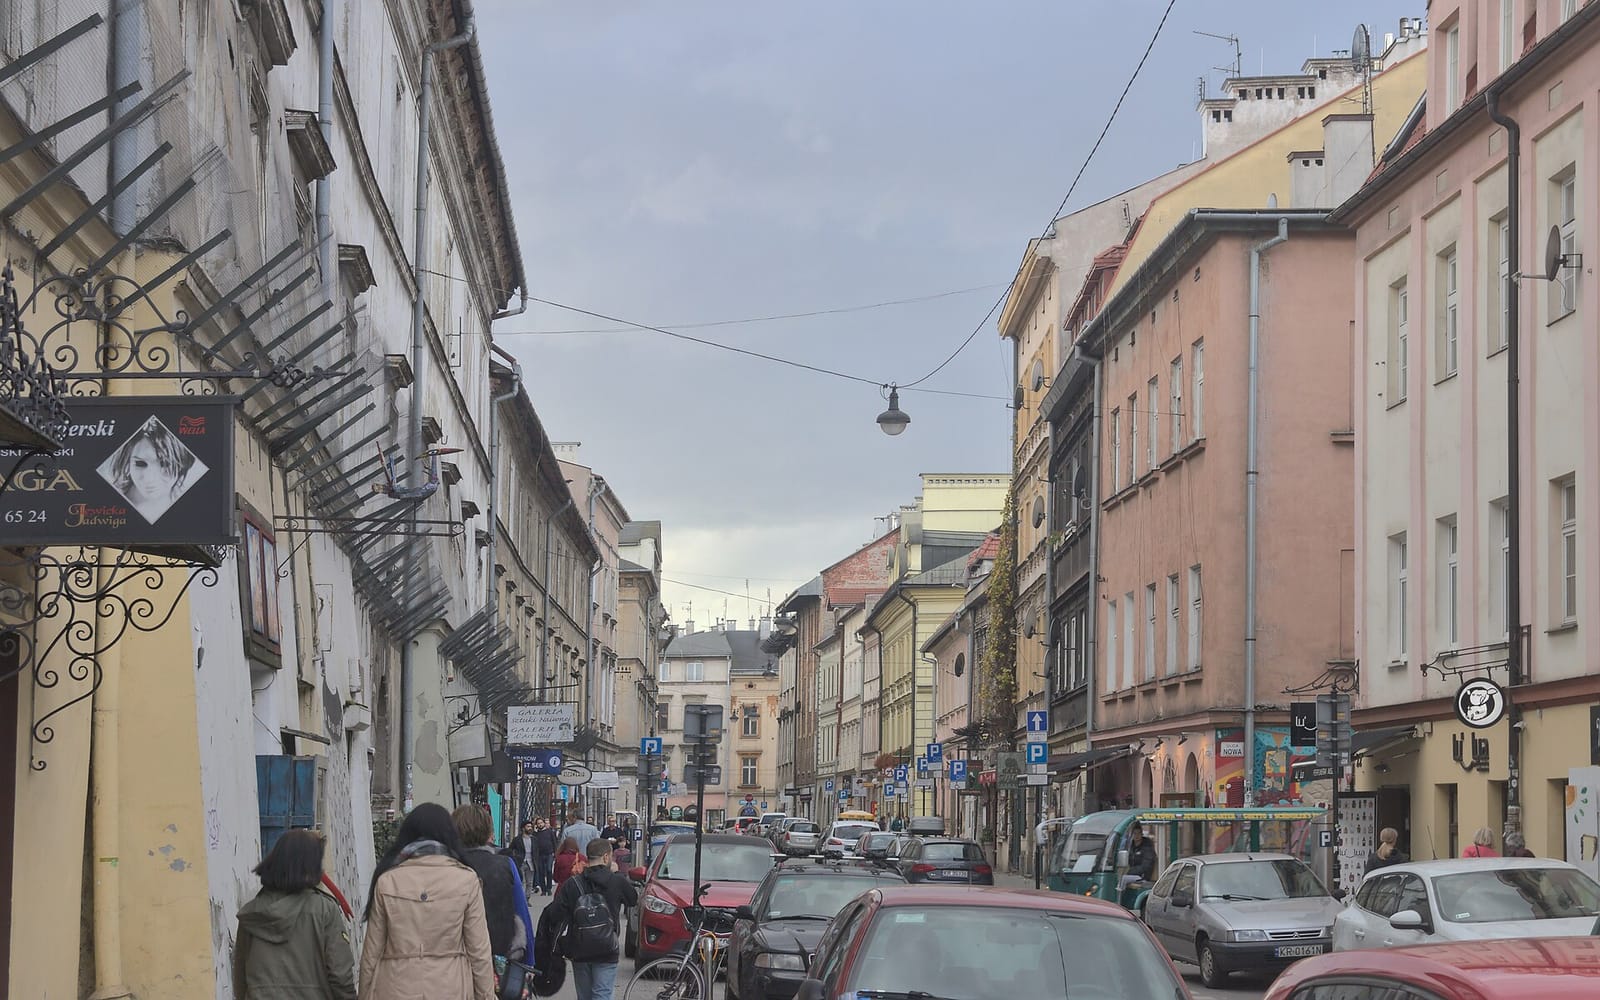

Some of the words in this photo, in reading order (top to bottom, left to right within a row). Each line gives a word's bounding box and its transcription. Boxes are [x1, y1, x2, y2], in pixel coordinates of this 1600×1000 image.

[5, 510, 23, 523] 65
[28, 510, 47, 523] 24
[64, 503, 127, 529] Jadwiga
[645, 740, 658, 755] P
[930, 745, 939, 757] P
[1031, 744, 1043, 762] P
[920, 759, 928, 770] P
[953, 762, 963, 775] P
[896, 770, 904, 780] P
[826, 781, 832, 789] P
[886, 785, 893, 795] P
[841, 790, 847, 799] P
[634, 830, 641, 840] P
[1321, 832, 1330, 846] P
[1280, 946, 1292, 956] KR
[1295, 945, 1321, 956] 0161N
